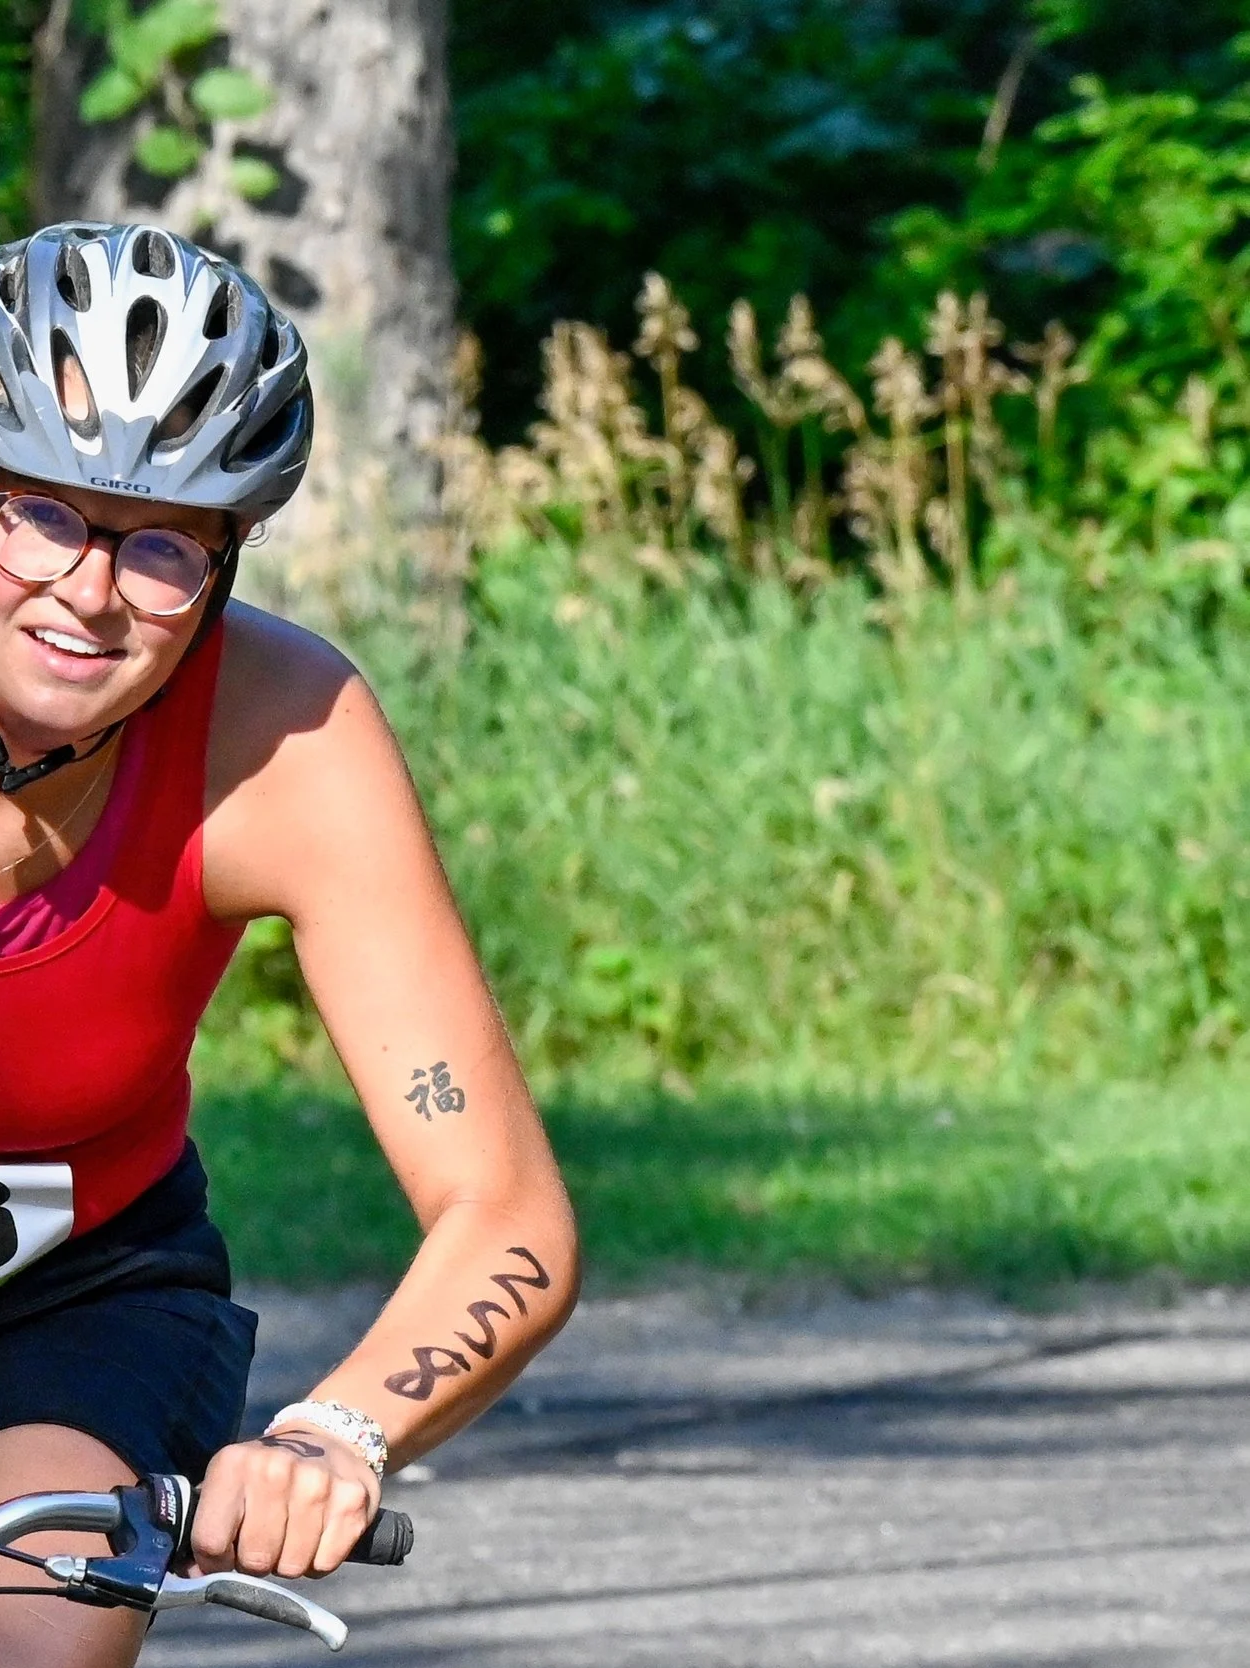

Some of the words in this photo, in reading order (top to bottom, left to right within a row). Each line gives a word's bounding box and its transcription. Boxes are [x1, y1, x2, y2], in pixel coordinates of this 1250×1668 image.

[90, 477, 151, 494] GIRO
[404, 1060, 466, 1122] 福
[383, 1246, 551, 1402] 258
